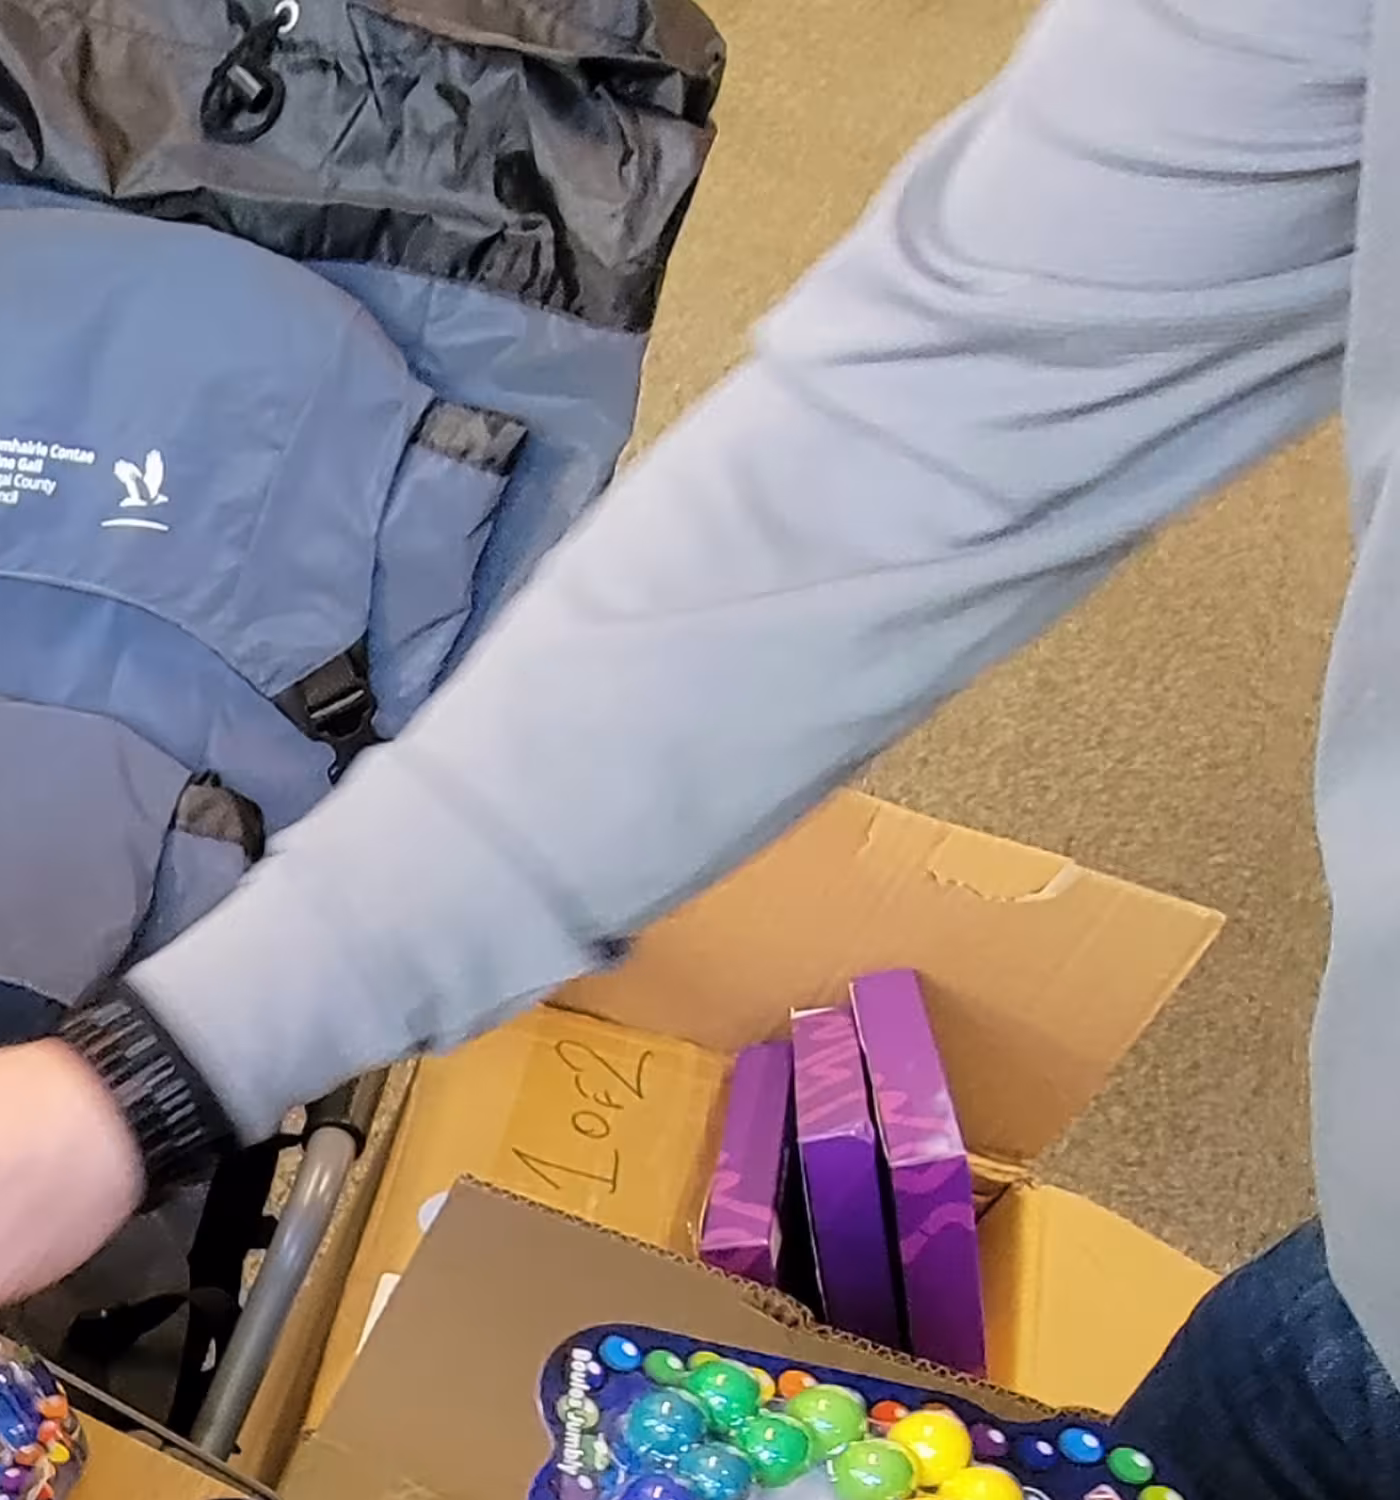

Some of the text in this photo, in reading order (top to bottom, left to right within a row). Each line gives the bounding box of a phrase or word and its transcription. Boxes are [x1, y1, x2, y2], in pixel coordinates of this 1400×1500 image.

[50, 443, 95, 464] Contae
[17, 457, 43, 473] Gall
[14, 474, 57, 496] County
[554, 1039, 654, 1099] 2
